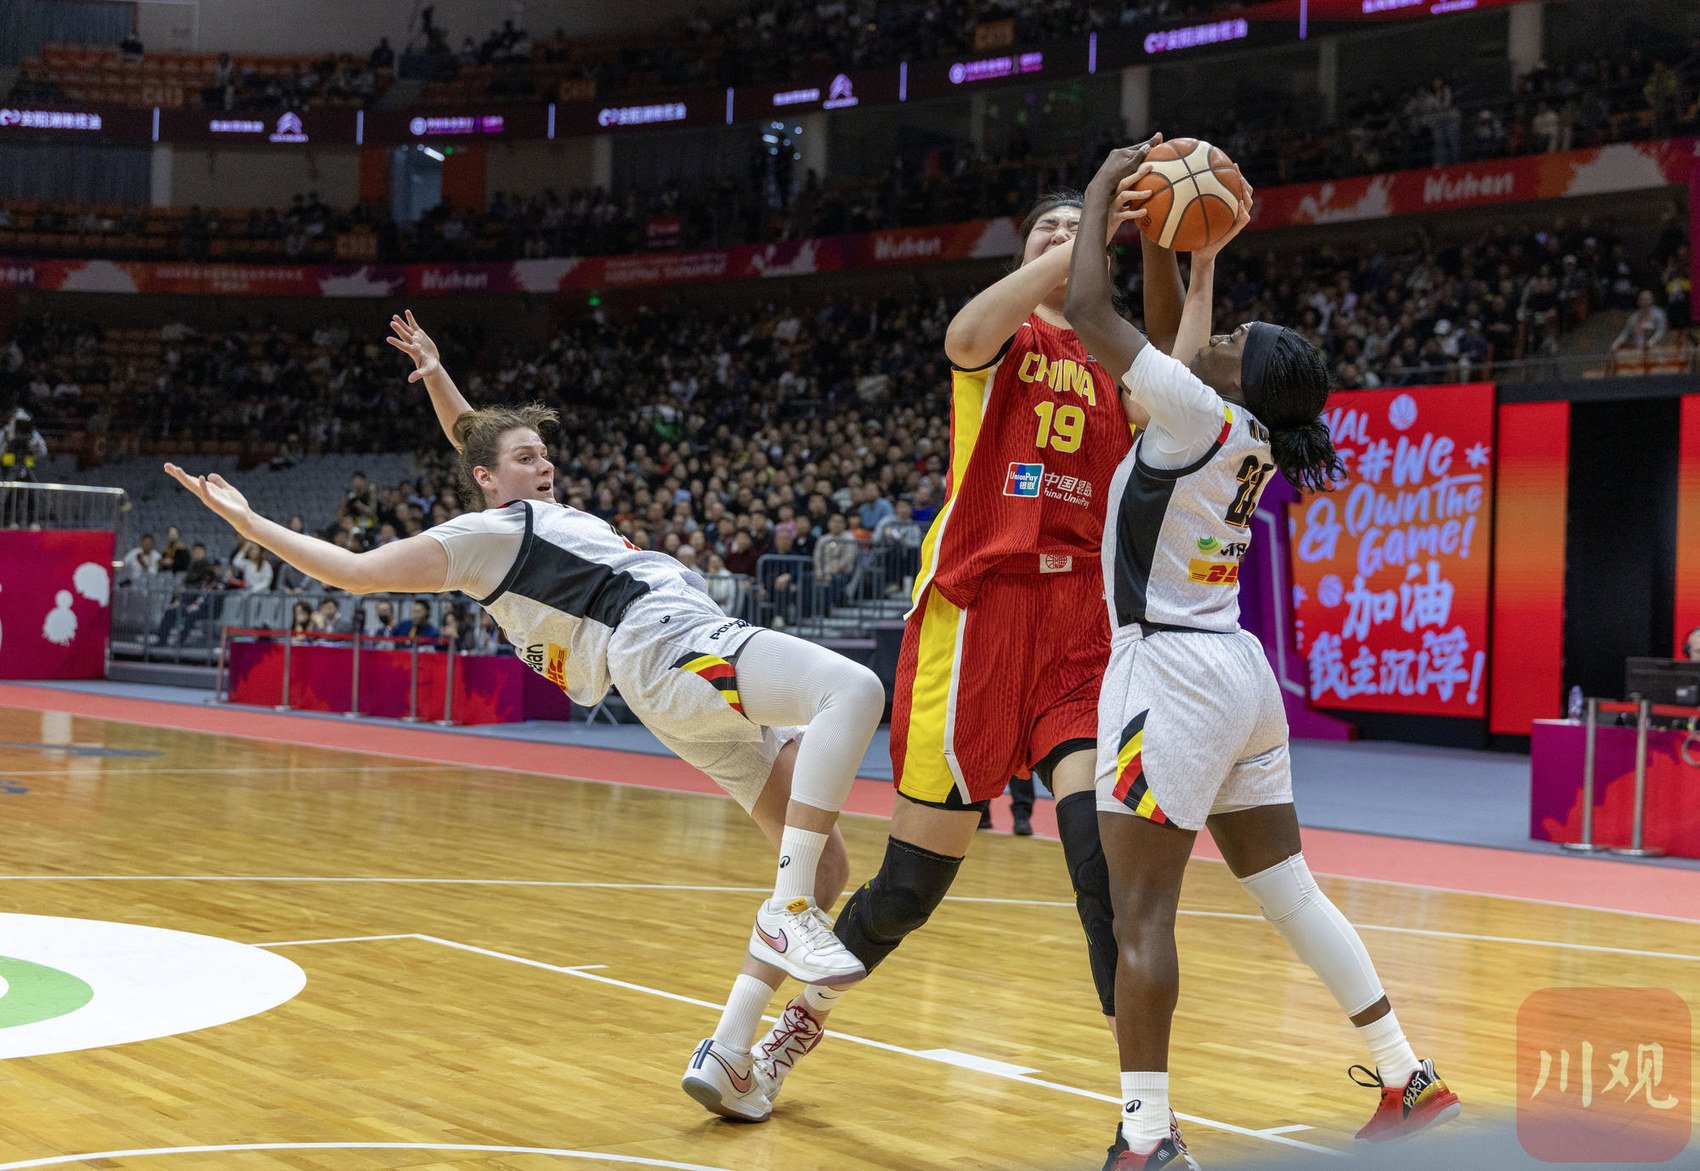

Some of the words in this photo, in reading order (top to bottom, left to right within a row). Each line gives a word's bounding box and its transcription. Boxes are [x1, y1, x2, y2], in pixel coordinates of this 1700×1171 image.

[1018, 351, 1096, 406] CHINA
[1034, 401, 1085, 453] 19
[1010, 471, 1038, 484] UnionPay
[1043, 487, 1062, 500] hina
[1342, 560, 1454, 642] 加油
[1403, 1071, 1429, 1109] BEAST
